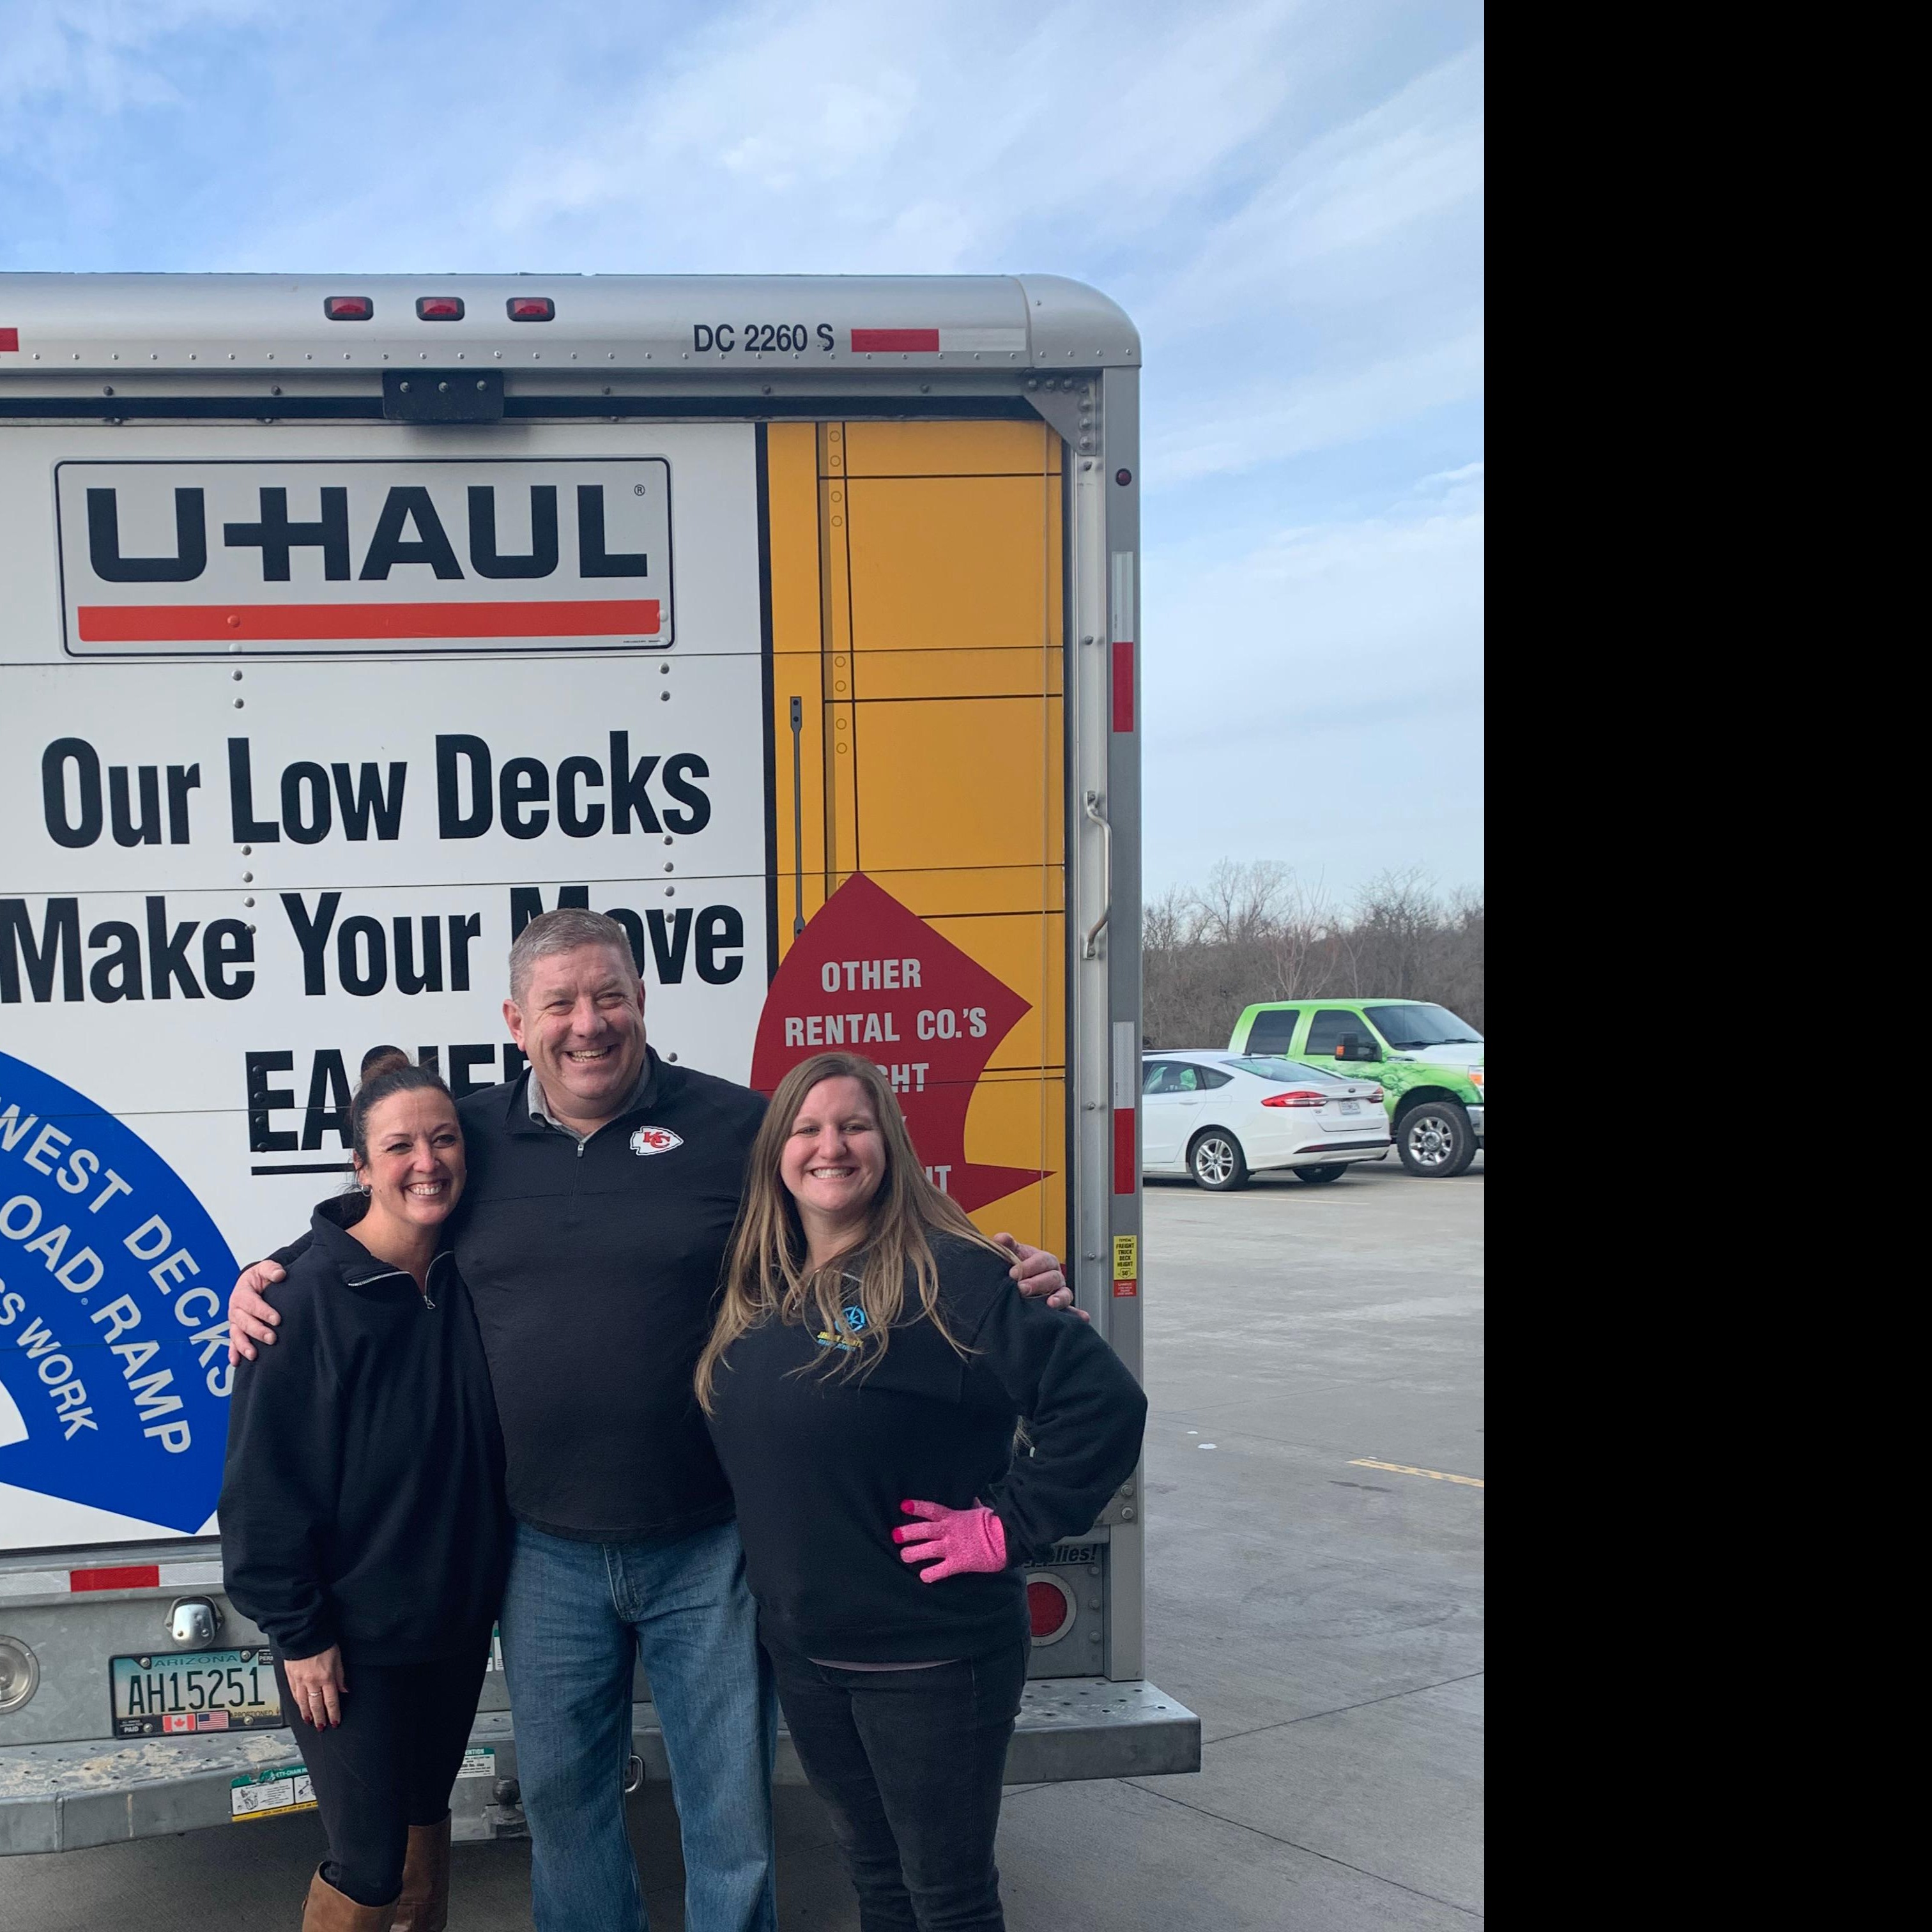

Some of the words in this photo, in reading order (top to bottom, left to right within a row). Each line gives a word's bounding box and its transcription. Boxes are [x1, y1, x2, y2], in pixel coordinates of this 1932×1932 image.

[694, 324, 735, 352] DC
[744, 324, 808, 351] 2260
[816, 323, 834, 351] S
[86, 484, 647, 583] U-HAUL
[42, 737, 201, 848] Our
[227, 737, 408, 845] Low
[435, 730, 711, 840] Decks
[0, 895, 256, 1004] Make
[279, 891, 481, 998] Your
[821, 958, 922, 993] OTHER
[785, 1012, 901, 1047] RENTAL
[916, 1006, 988, 1041] CO.'S
[643, 1131, 671, 1149] KC
[16, 1316, 98, 1441] WORK
[90, 1293, 192, 1453] RAMP
[154, 1653, 238, 1667] ARIZONA
[128, 1666, 265, 1715] AH15251
